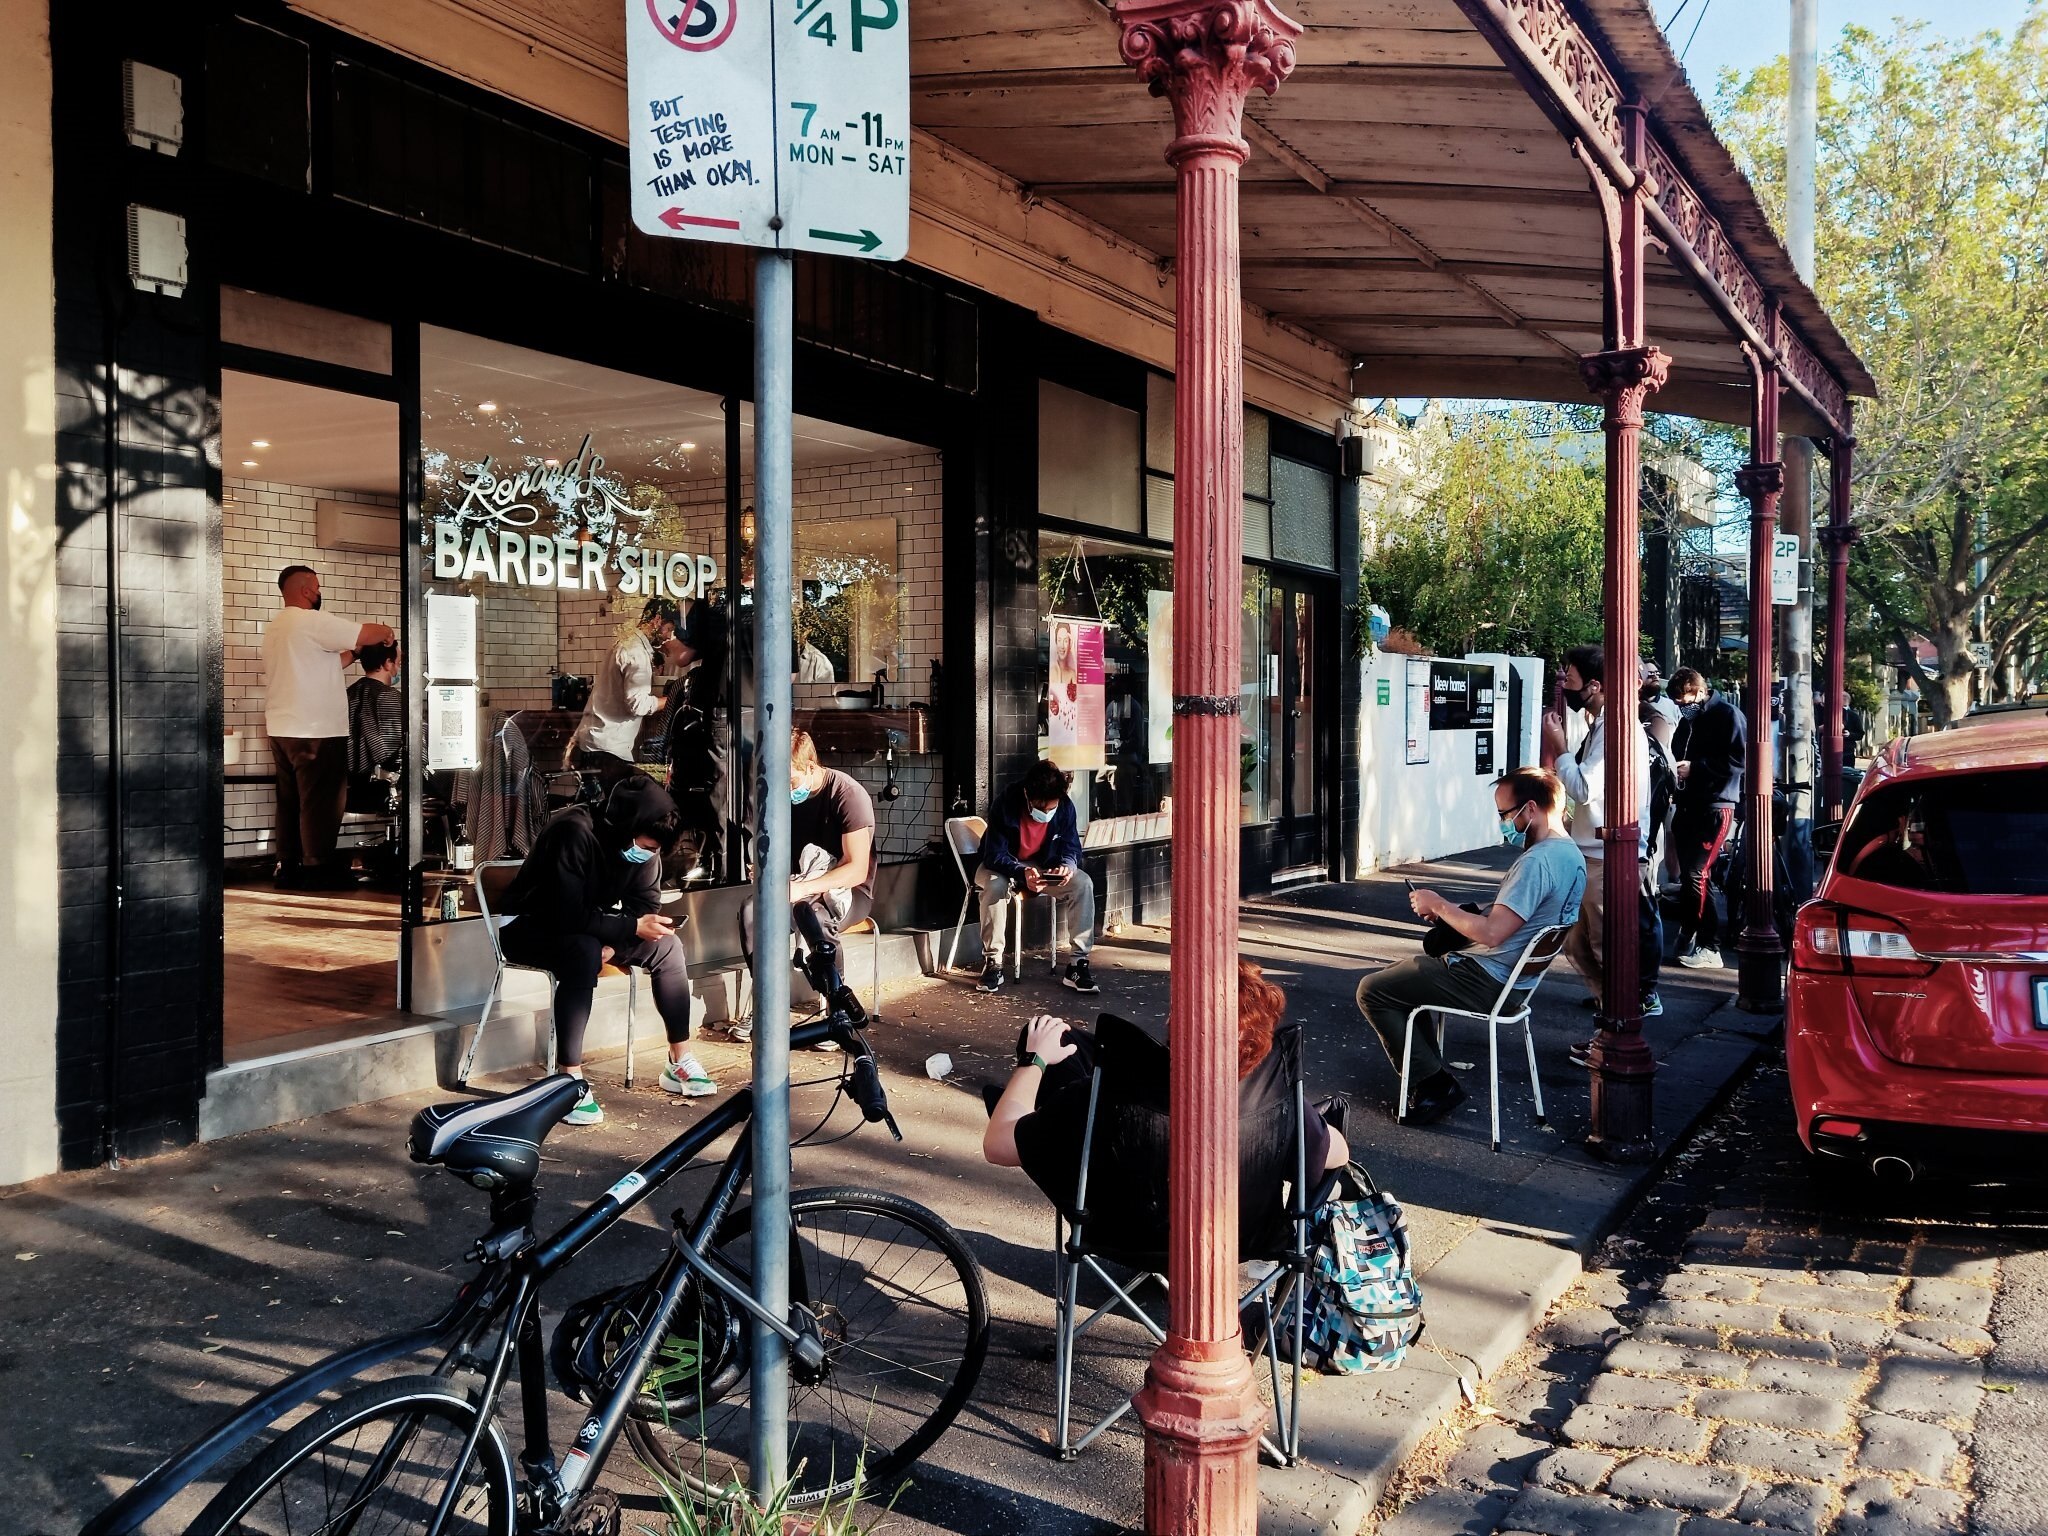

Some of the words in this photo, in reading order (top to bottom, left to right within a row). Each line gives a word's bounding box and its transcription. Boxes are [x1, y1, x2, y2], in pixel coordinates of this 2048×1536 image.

[650, 95, 684, 121] BUT
[650, 112, 728, 146] TESTING
[652, 149, 673, 170] IS
[682, 134, 734, 163] MORE
[789, 143, 834, 166] MON
[868, 153, 905, 176] SAT
[646, 169, 697, 198] THAN
[706, 158, 760, 187] OKAY.
[434, 522, 607, 592] BARBER
[617, 546, 719, 600] SHOP
[1775, 541, 1797, 558] 2P
[1449, 675, 1467, 692] homes
